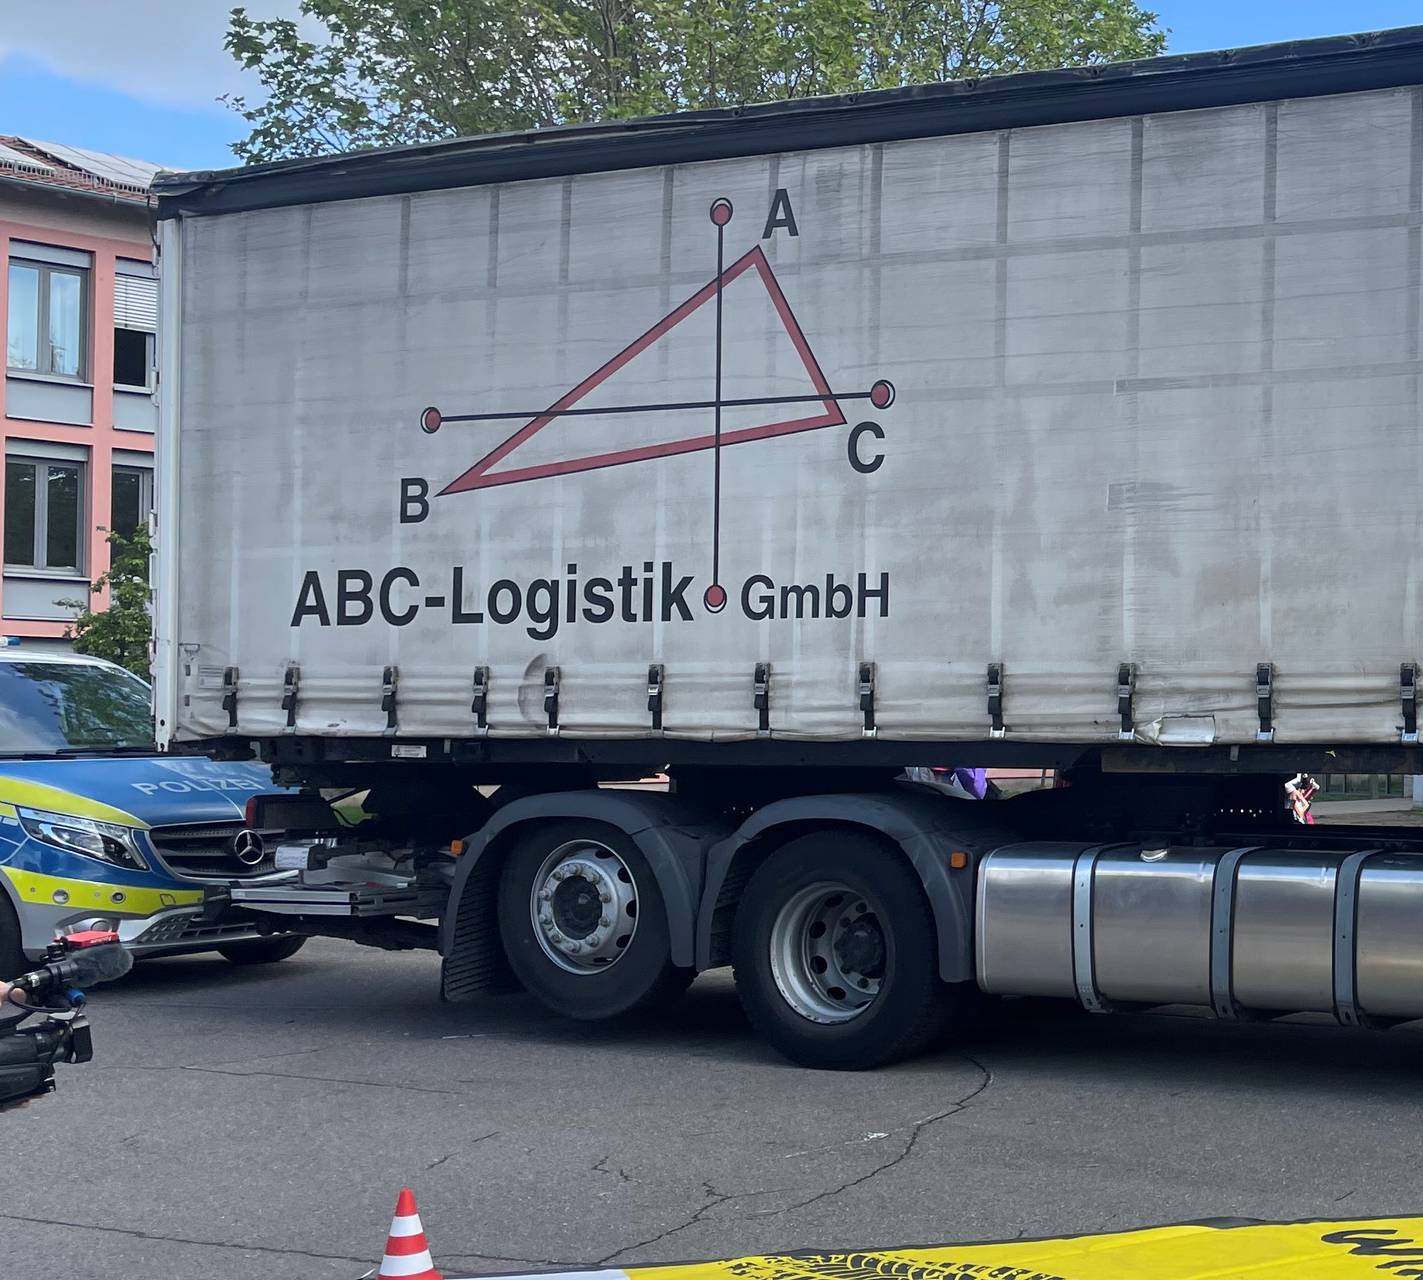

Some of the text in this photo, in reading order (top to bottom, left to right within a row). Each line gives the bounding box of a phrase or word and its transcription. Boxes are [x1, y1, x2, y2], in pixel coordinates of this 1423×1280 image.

[761, 188, 800, 240] A
[846, 420, 886, 474] C
[399, 477, 430, 524] B
[290, 561, 890, 641] ABC-Logistik GmbH
[130, 778, 266, 796] POLIZEI
